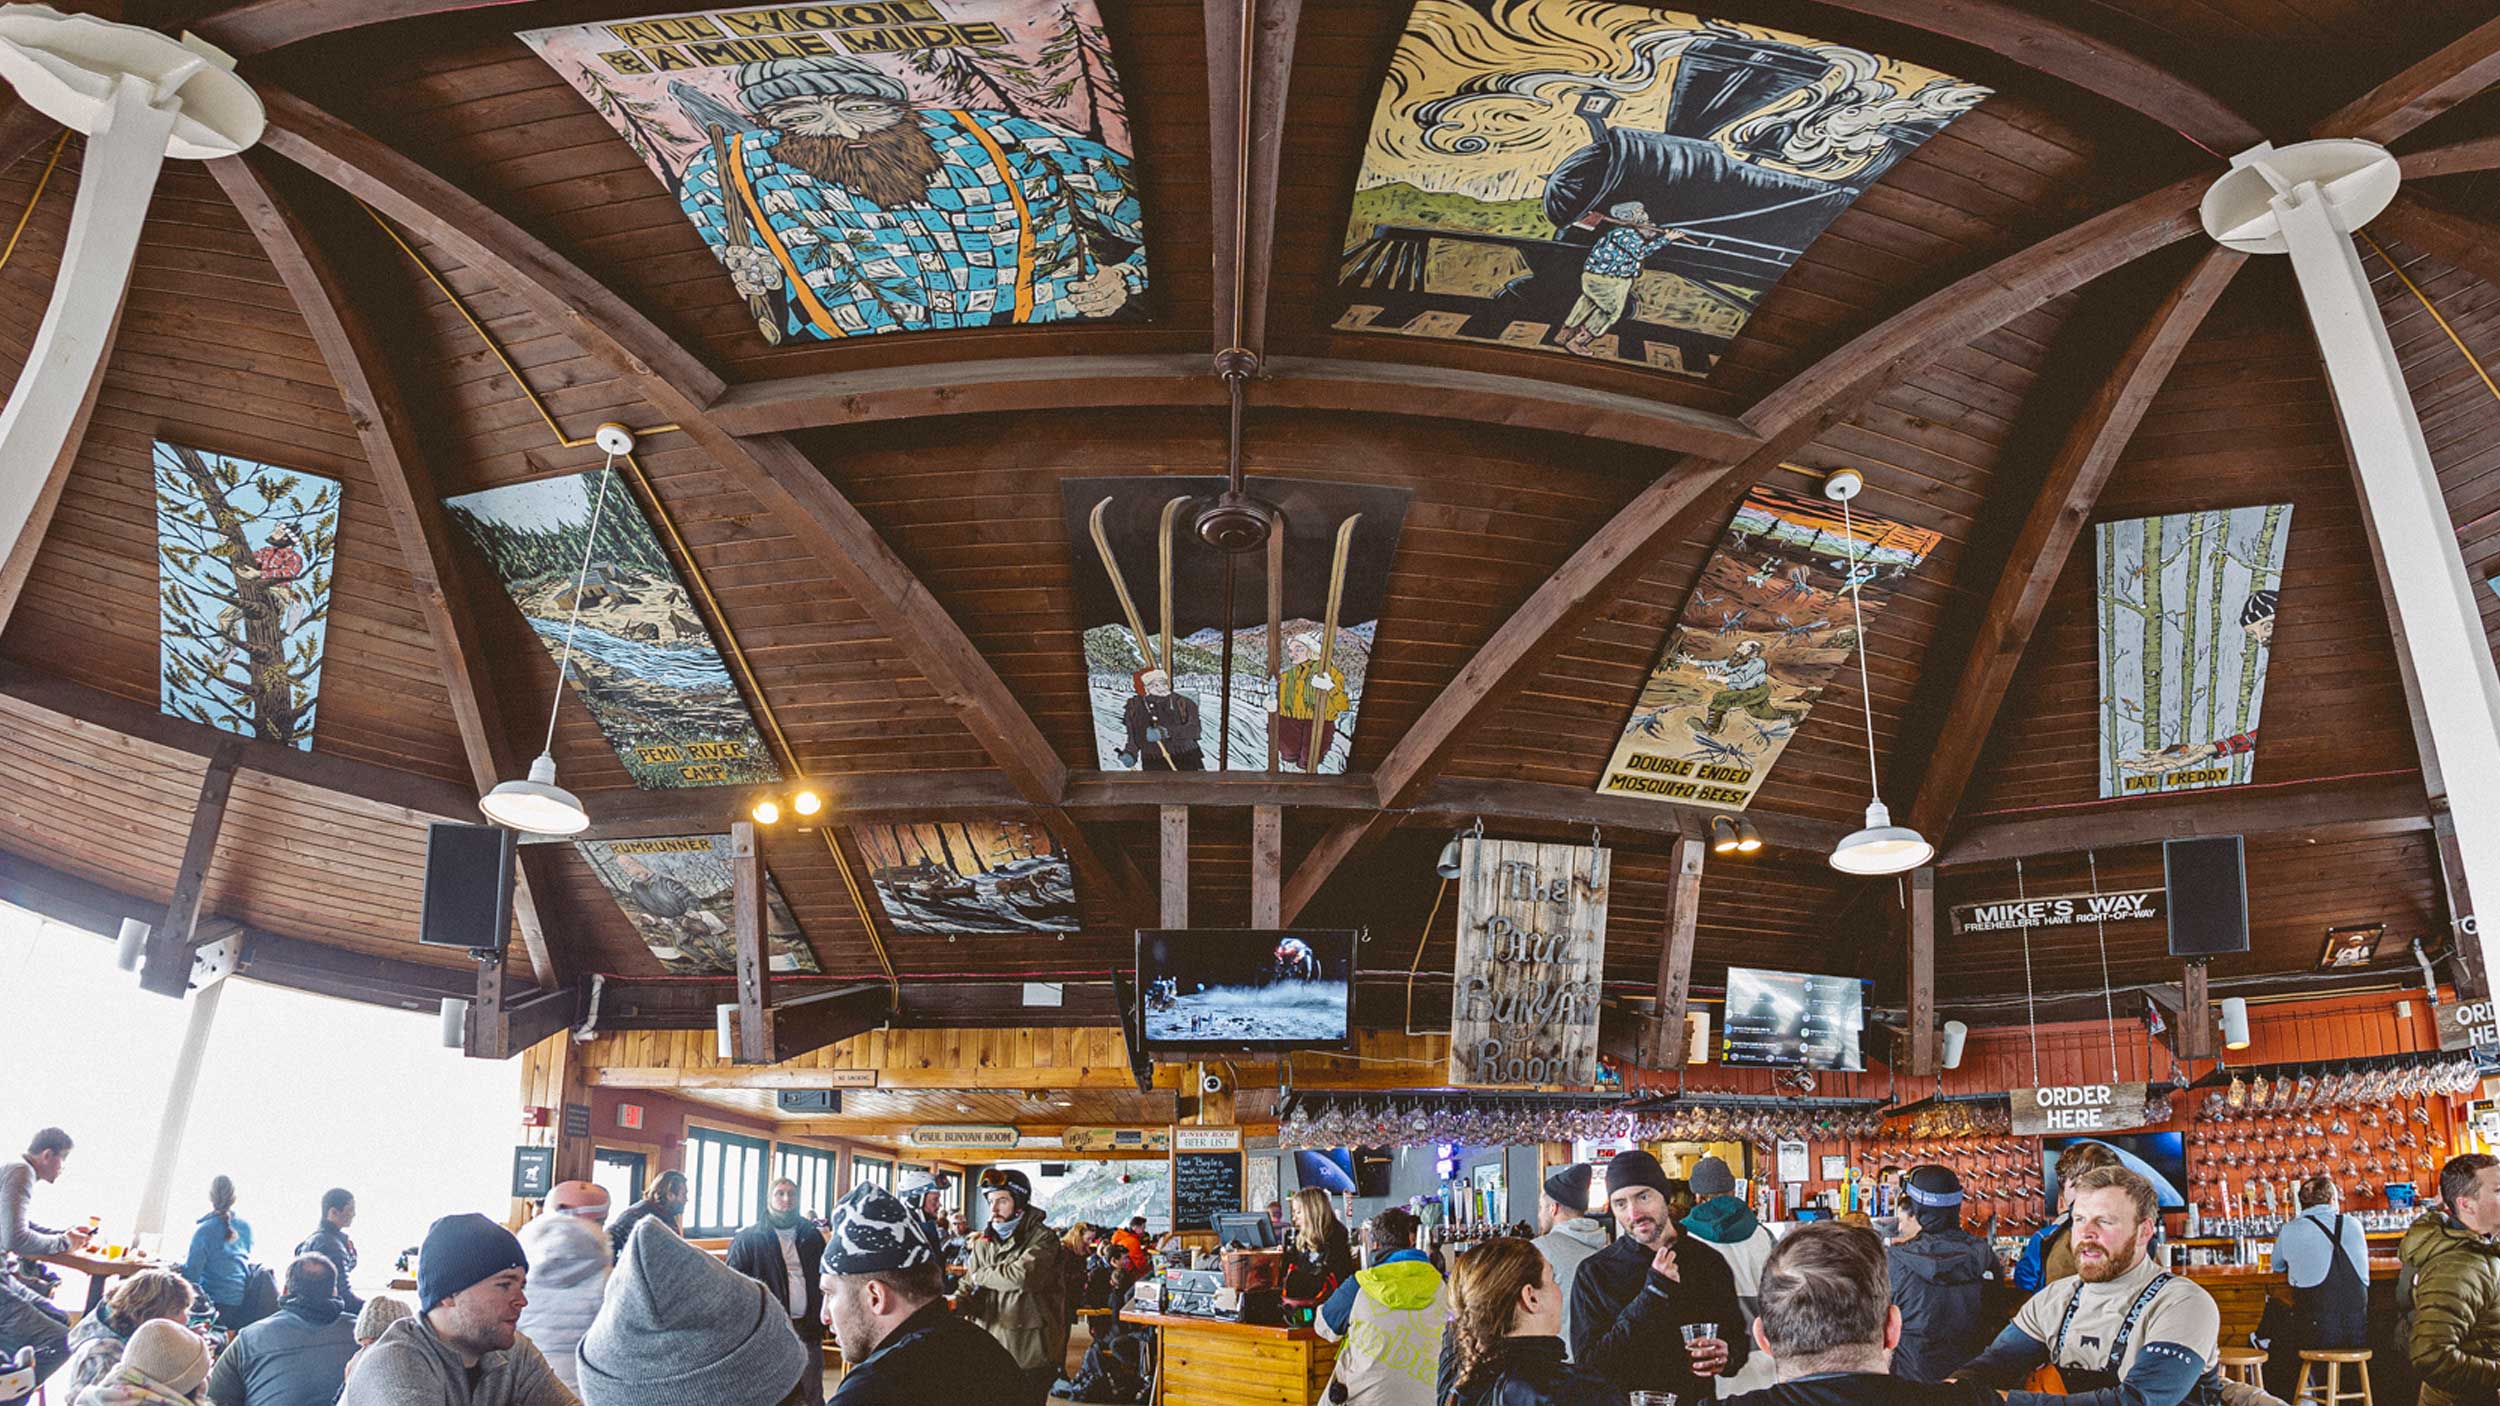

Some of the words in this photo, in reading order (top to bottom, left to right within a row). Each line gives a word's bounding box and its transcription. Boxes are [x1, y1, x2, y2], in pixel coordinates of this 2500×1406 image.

[623, 19, 718, 45] ALL
[724, 1, 940, 33] WOOL
[654, 49, 689, 71] A
[694, 34, 831, 66] MILE
[841, 22, 1002, 51] WIDE
[637, 747, 680, 762] PEMI
[687, 742, 746, 759] RIVER
[680, 765, 722, 780] CAMP
[1626, 754, 1694, 776] DOUBLE
[1696, 763, 1752, 783] ENDED
[1607, 773, 1697, 797] MOSQUITO
[1698, 785, 1750, 804] BEES!
[609, 840, 713, 854] RUMRUNNER
[1974, 900, 2074, 923] MIKE'S
[2087, 893, 2148, 913] WAY
[1964, 917, 2040, 932] FREEHEELERS
[2044, 915, 2071, 926] HAVE
[2076, 908, 2156, 923] RIGHT-OF-WAY
[2036, 1085, 2111, 1107] ORDER
[2047, 1108, 2103, 1129] HERE
[919, 1132, 942, 1142] PAUL
[944, 1132, 981, 1142] BUNYAN
[984, 1132, 1012, 1143] ROOM
[1184, 1138, 1206, 1147] BEER
[1210, 1138, 1228, 1147] LIST
[2127, 1276, 2166, 1323] MONTEC
[2146, 1345, 2192, 1364] MONTEC
